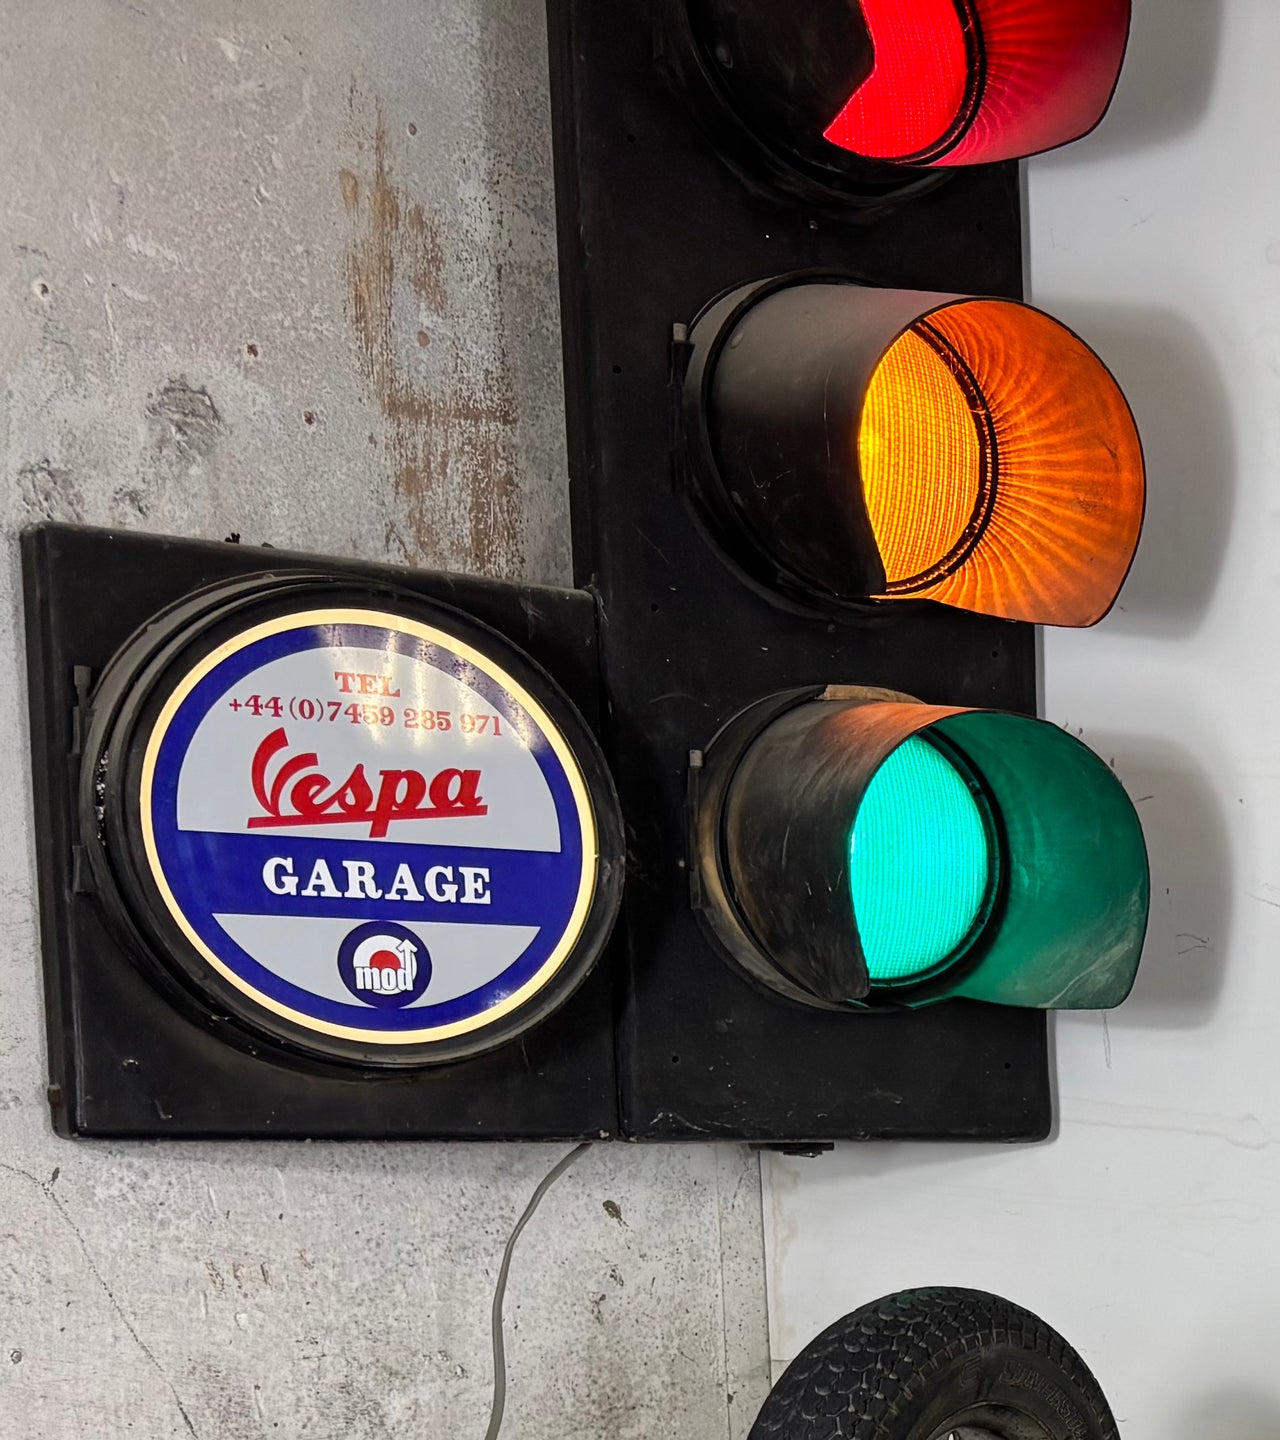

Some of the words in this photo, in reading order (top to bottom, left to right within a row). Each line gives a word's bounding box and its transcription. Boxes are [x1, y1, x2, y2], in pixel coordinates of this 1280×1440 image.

[335, 671, 401, 698] TEL
[404, 708, 451, 731] 285
[460, 714, 502, 736] 971
[247, 727, 488, 838] Vespa
[263, 857, 491, 904] GARAGE
[355, 940, 417, 991] mod
